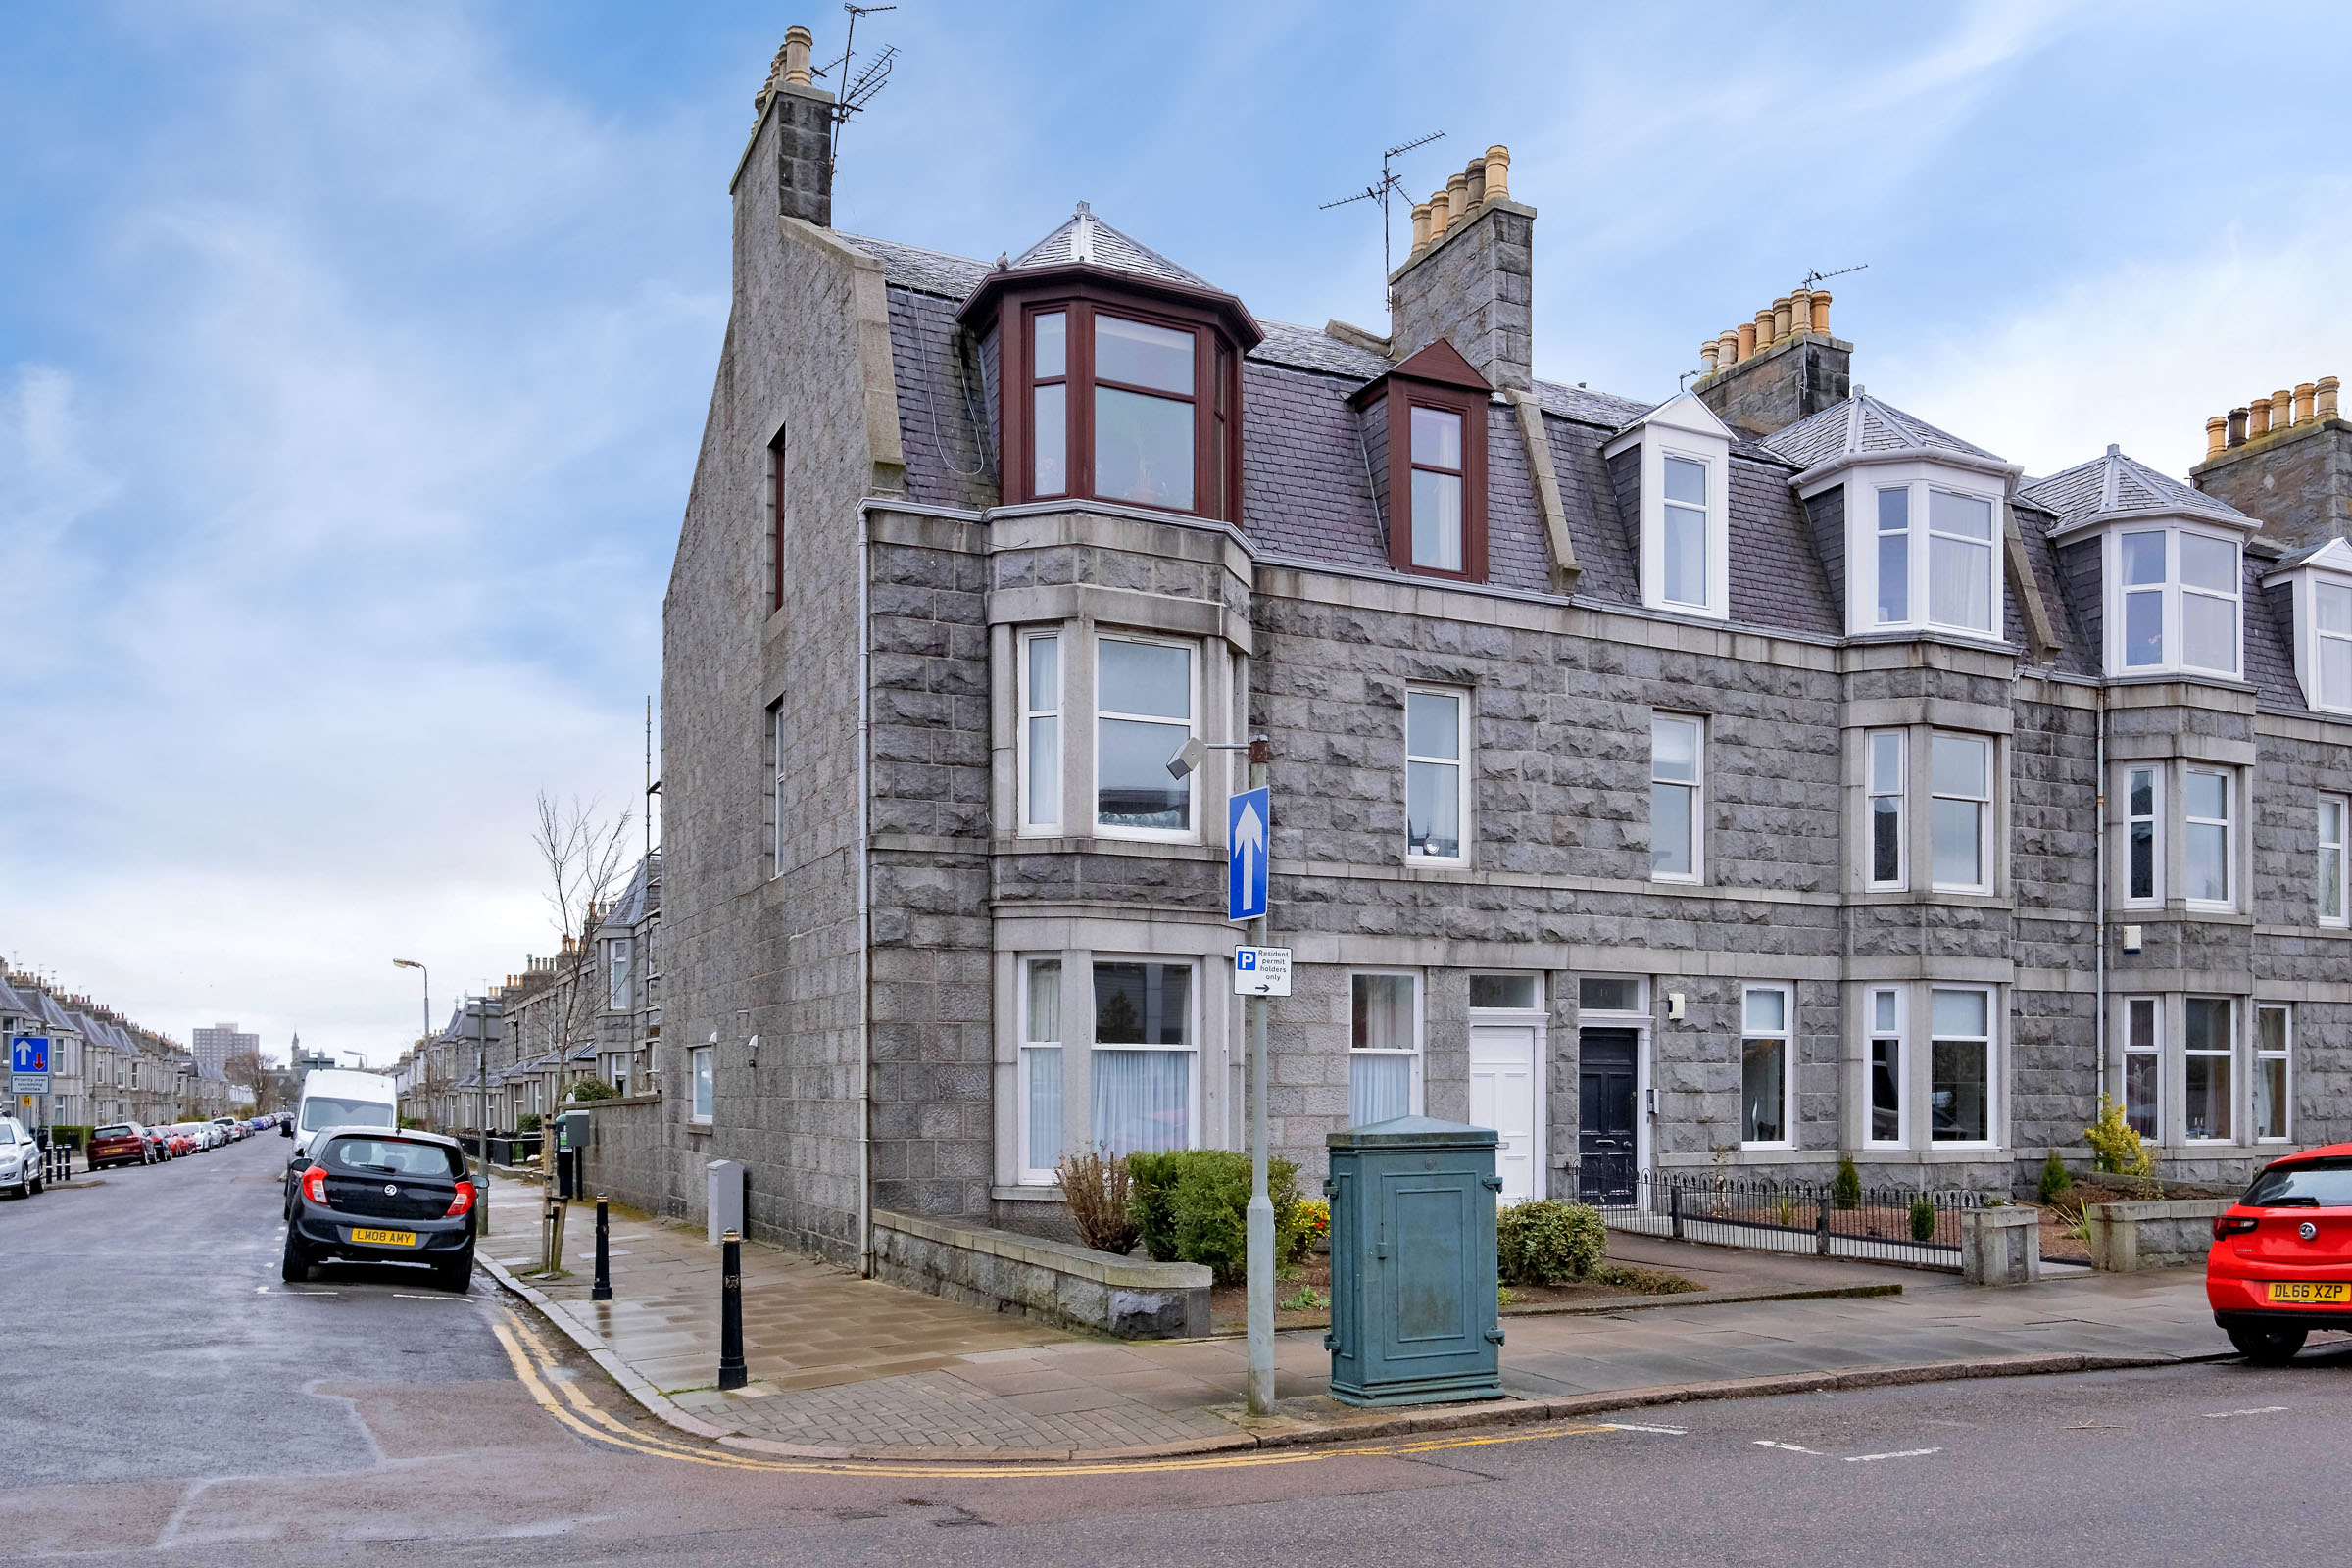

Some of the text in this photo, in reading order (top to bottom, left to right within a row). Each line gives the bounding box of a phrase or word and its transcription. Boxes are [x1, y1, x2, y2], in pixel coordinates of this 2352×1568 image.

[1241, 952, 1254, 969] P
[357, 1230, 412, 1244] LM08 AMY
[2274, 1284, 2343, 1298] DL66 XZP
